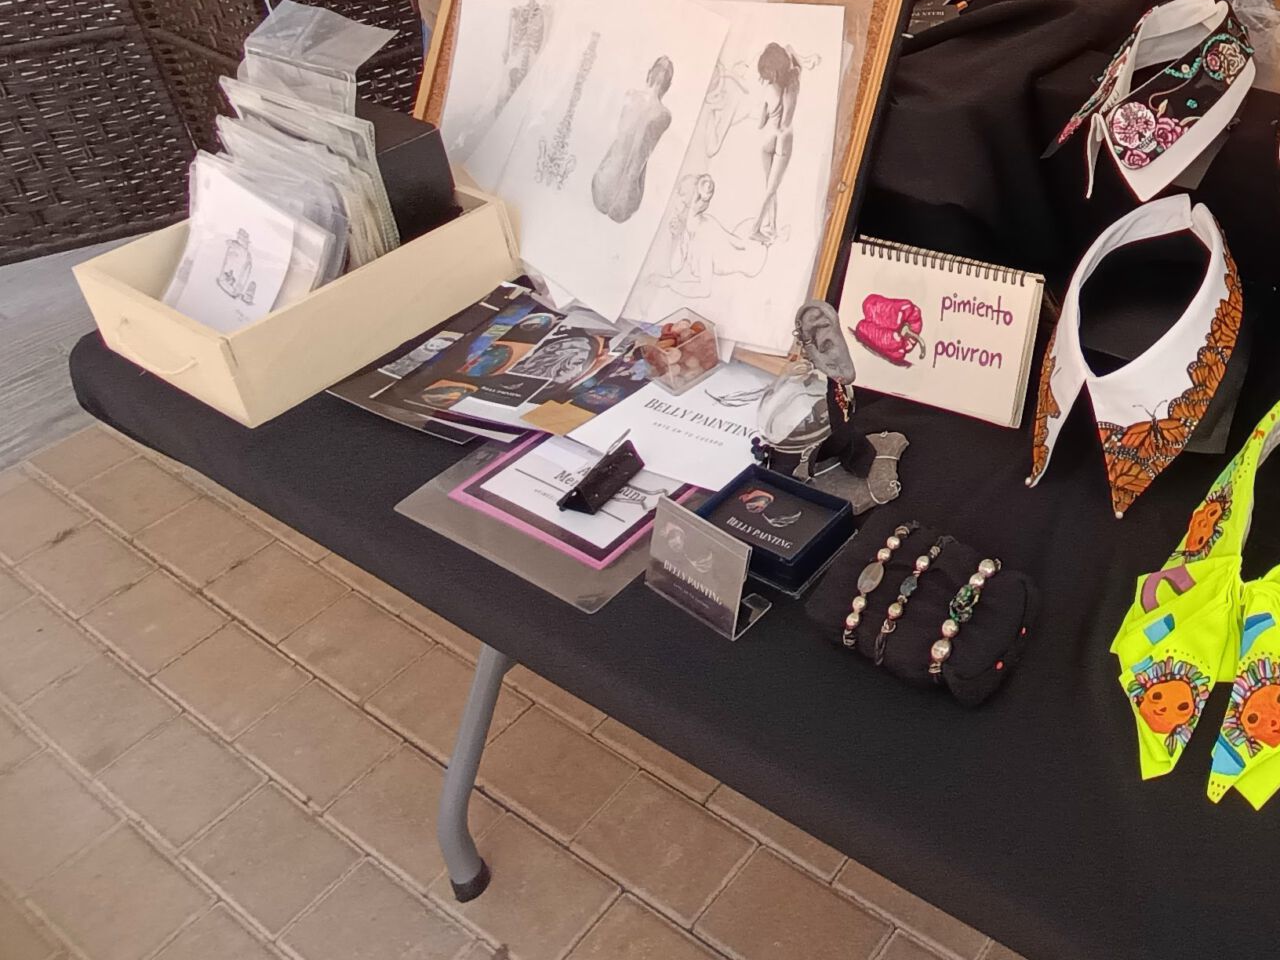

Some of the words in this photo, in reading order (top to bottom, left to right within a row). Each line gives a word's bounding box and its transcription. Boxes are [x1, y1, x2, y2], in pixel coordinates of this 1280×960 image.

[940, 292, 1013, 326] pimiento
[932, 339, 1002, 369] poivron
[644, 398, 693, 419] BELLY
[726, 516, 755, 533] BELLY
[750, 529, 794, 549] PAINTING
